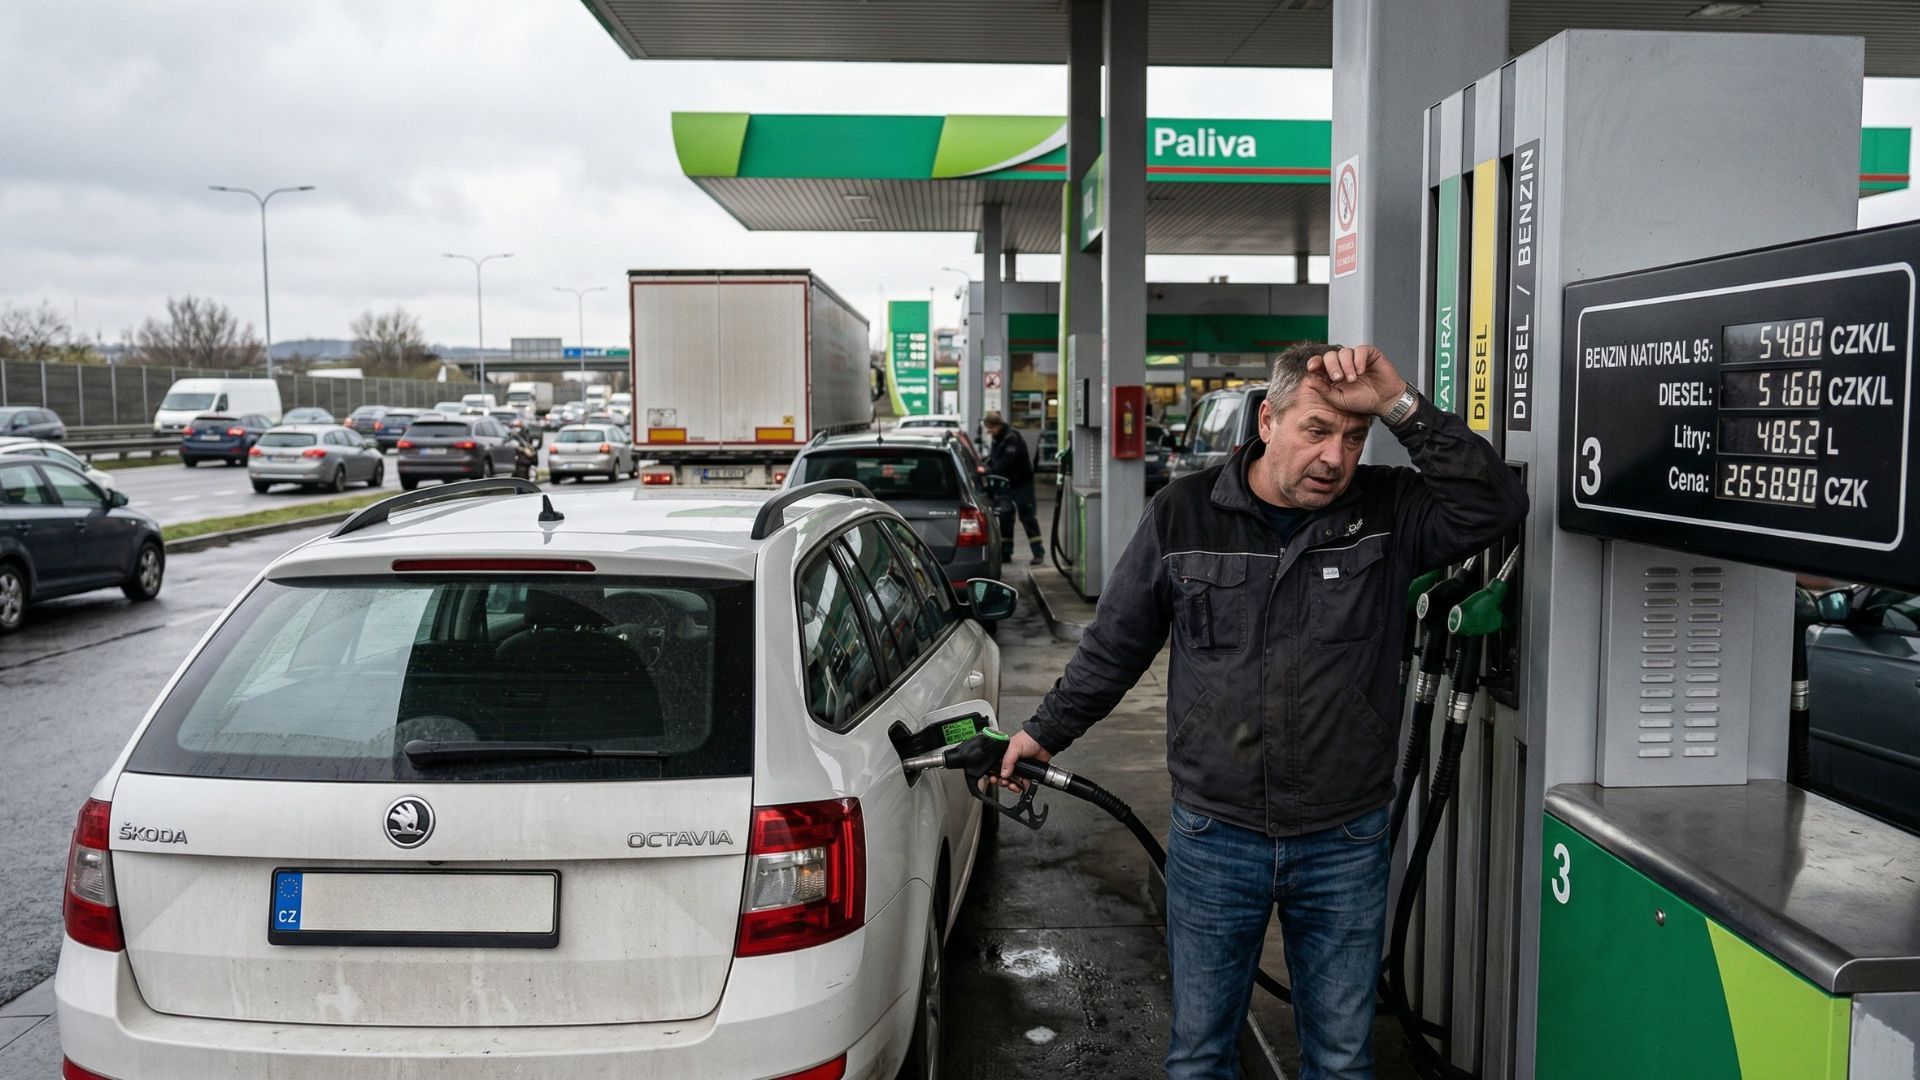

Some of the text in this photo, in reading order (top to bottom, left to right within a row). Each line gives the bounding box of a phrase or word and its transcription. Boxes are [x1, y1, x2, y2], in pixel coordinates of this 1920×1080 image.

[1154, 127, 1257, 158] Paliva
[1513, 149, 1534, 419] DIESEL / BENZIN
[1585, 320, 1896, 369] BENZIN NATURAL 95: 54.80 CZK/L
[1473, 323, 1487, 420] DIESEL
[1659, 370, 1893, 406] DIESEL: 51.60 CZK/L
[1674, 420, 1839, 455] Litry: 48.52 L
[1580, 436, 1601, 496] 3
[1668, 464, 1868, 508] Cena: 2658.90 CZK
[119, 821, 188, 845] ŠKODA
[626, 829, 734, 849] OCTAVIA
[1551, 842, 1571, 905] 3
[278, 909, 297, 924] CZ
